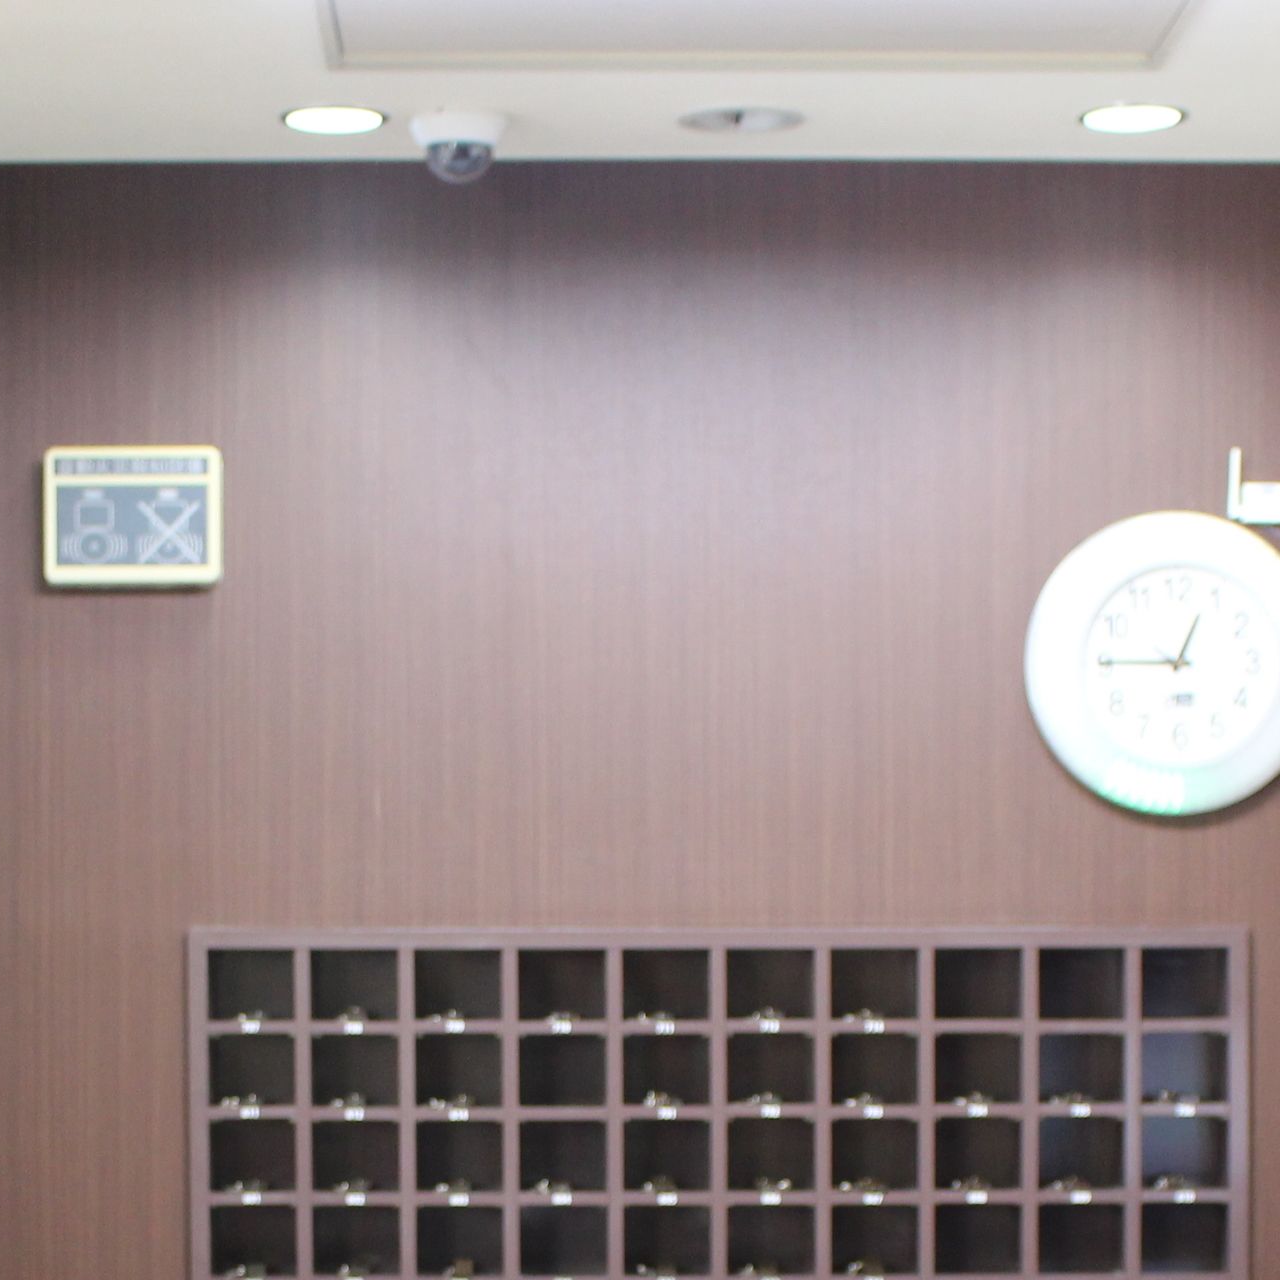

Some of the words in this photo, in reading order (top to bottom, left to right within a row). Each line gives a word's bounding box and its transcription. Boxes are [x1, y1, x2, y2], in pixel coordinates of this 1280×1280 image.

[1128, 586, 1151, 611] 11
[1164, 575, 1193, 602] 12
[1210, 586, 1221, 611] 1
[1104, 612, 1128, 640] 10
[1233, 611, 1249, 640] 2
[1246, 648, 1261, 675] 3
[1108, 689, 1125, 717] 8
[1233, 685, 1248, 710] 4
[1136, 713, 1151, 740] 7
[1172, 722, 1190, 752] 6
[1209, 711, 1226, 739] 5
